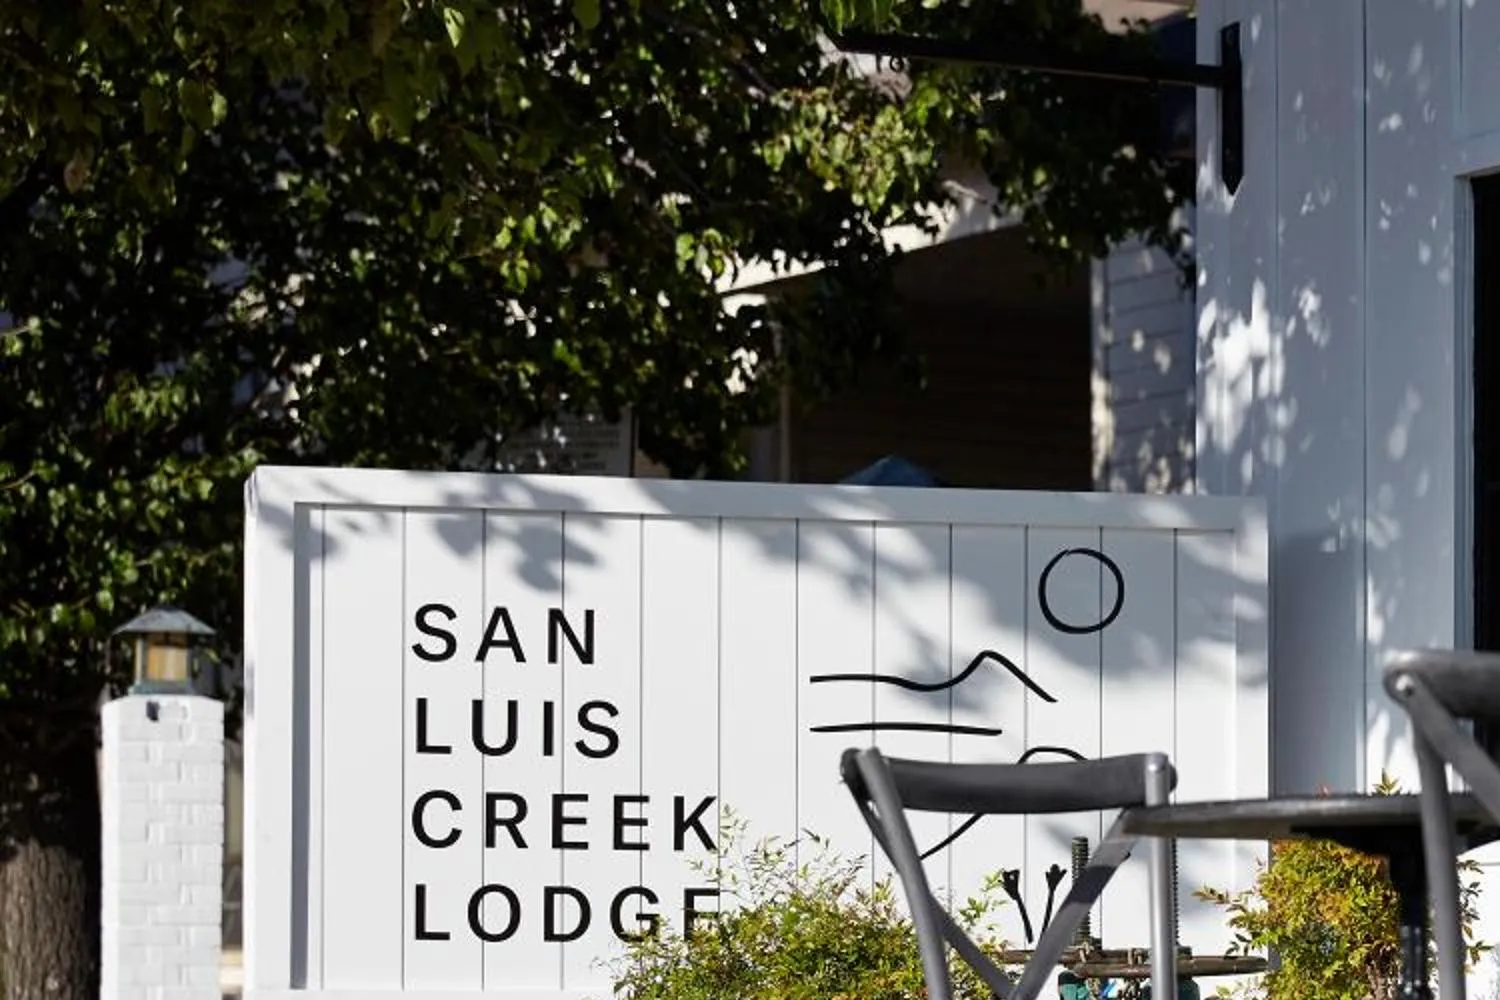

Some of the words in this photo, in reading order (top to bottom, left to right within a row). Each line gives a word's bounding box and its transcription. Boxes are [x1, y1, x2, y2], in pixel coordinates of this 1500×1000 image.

[411, 602, 595, 665] SAN
[415, 698, 620, 759] LUIS
[411, 790, 718, 851] CREEK
